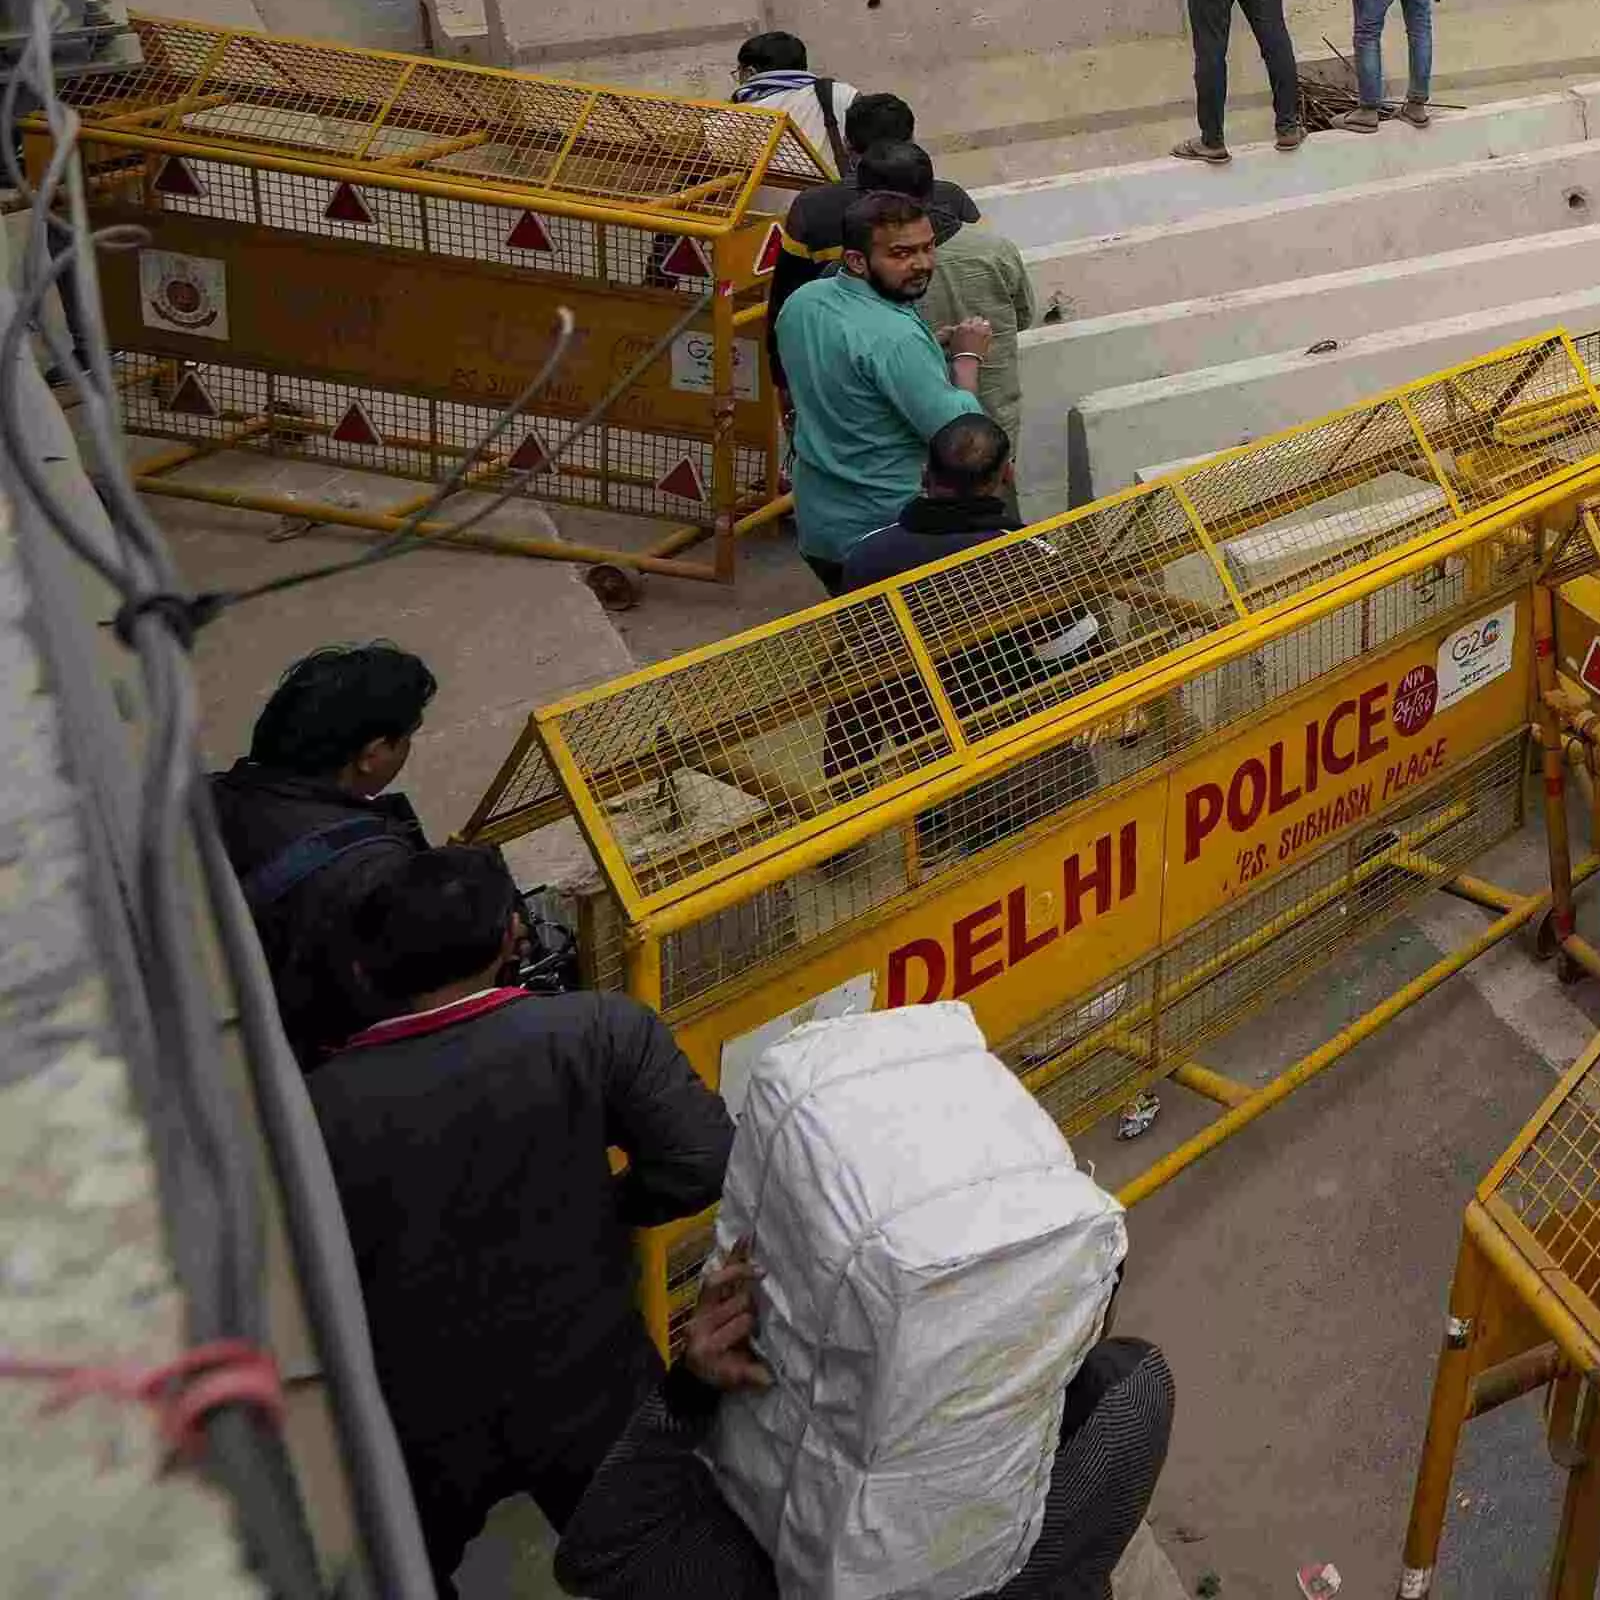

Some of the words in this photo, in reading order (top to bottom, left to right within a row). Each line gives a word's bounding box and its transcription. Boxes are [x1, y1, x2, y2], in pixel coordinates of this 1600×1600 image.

[887, 819, 1138, 1009] DELHI
[1183, 682, 1390, 865] POLICE
[1279, 782, 1374, 861] SUBHASH
[1382, 737, 1448, 802] PLACE
